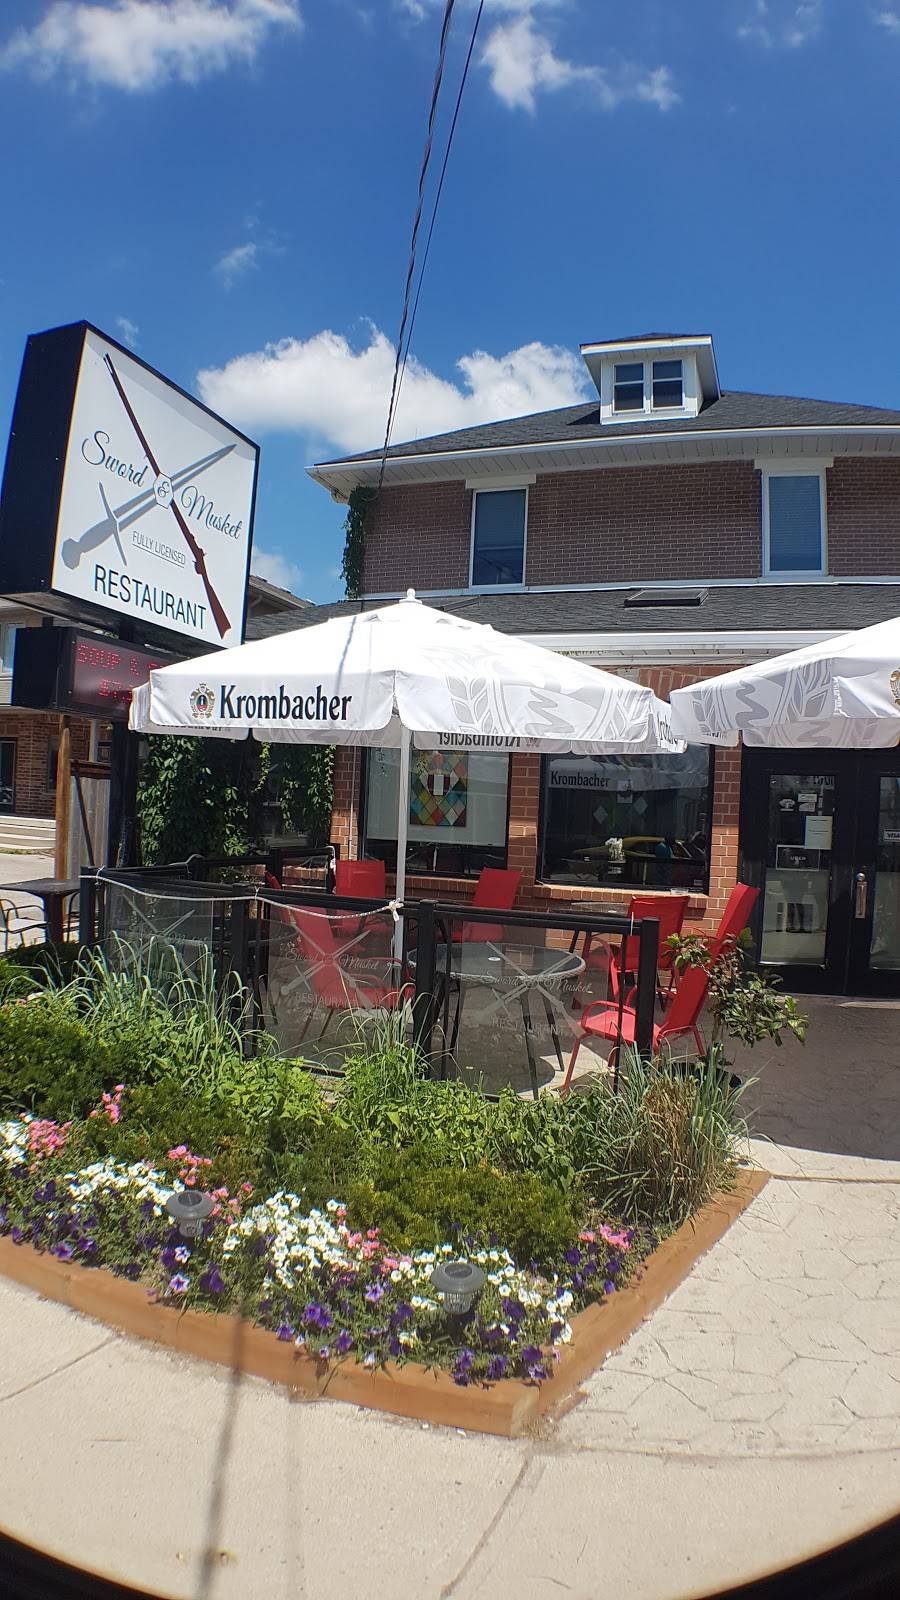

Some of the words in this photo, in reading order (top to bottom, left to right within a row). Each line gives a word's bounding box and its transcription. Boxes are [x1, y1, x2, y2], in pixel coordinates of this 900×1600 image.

[81, 430, 148, 487] Sword
[157, 481, 170, 497] &
[181, 485, 243, 540] Musket
[132, 530, 155, 549] FULLY
[155, 540, 186, 565] LICENSED
[93, 563, 207, 630] RESTAURANT
[78, 644, 121, 670] SOUP
[220, 684, 353, 721] Krombacher
[550, 770, 610, 788] Krombacher
[339, 953, 380, 970] Musket
[543, 978, 593, 993] Musket
